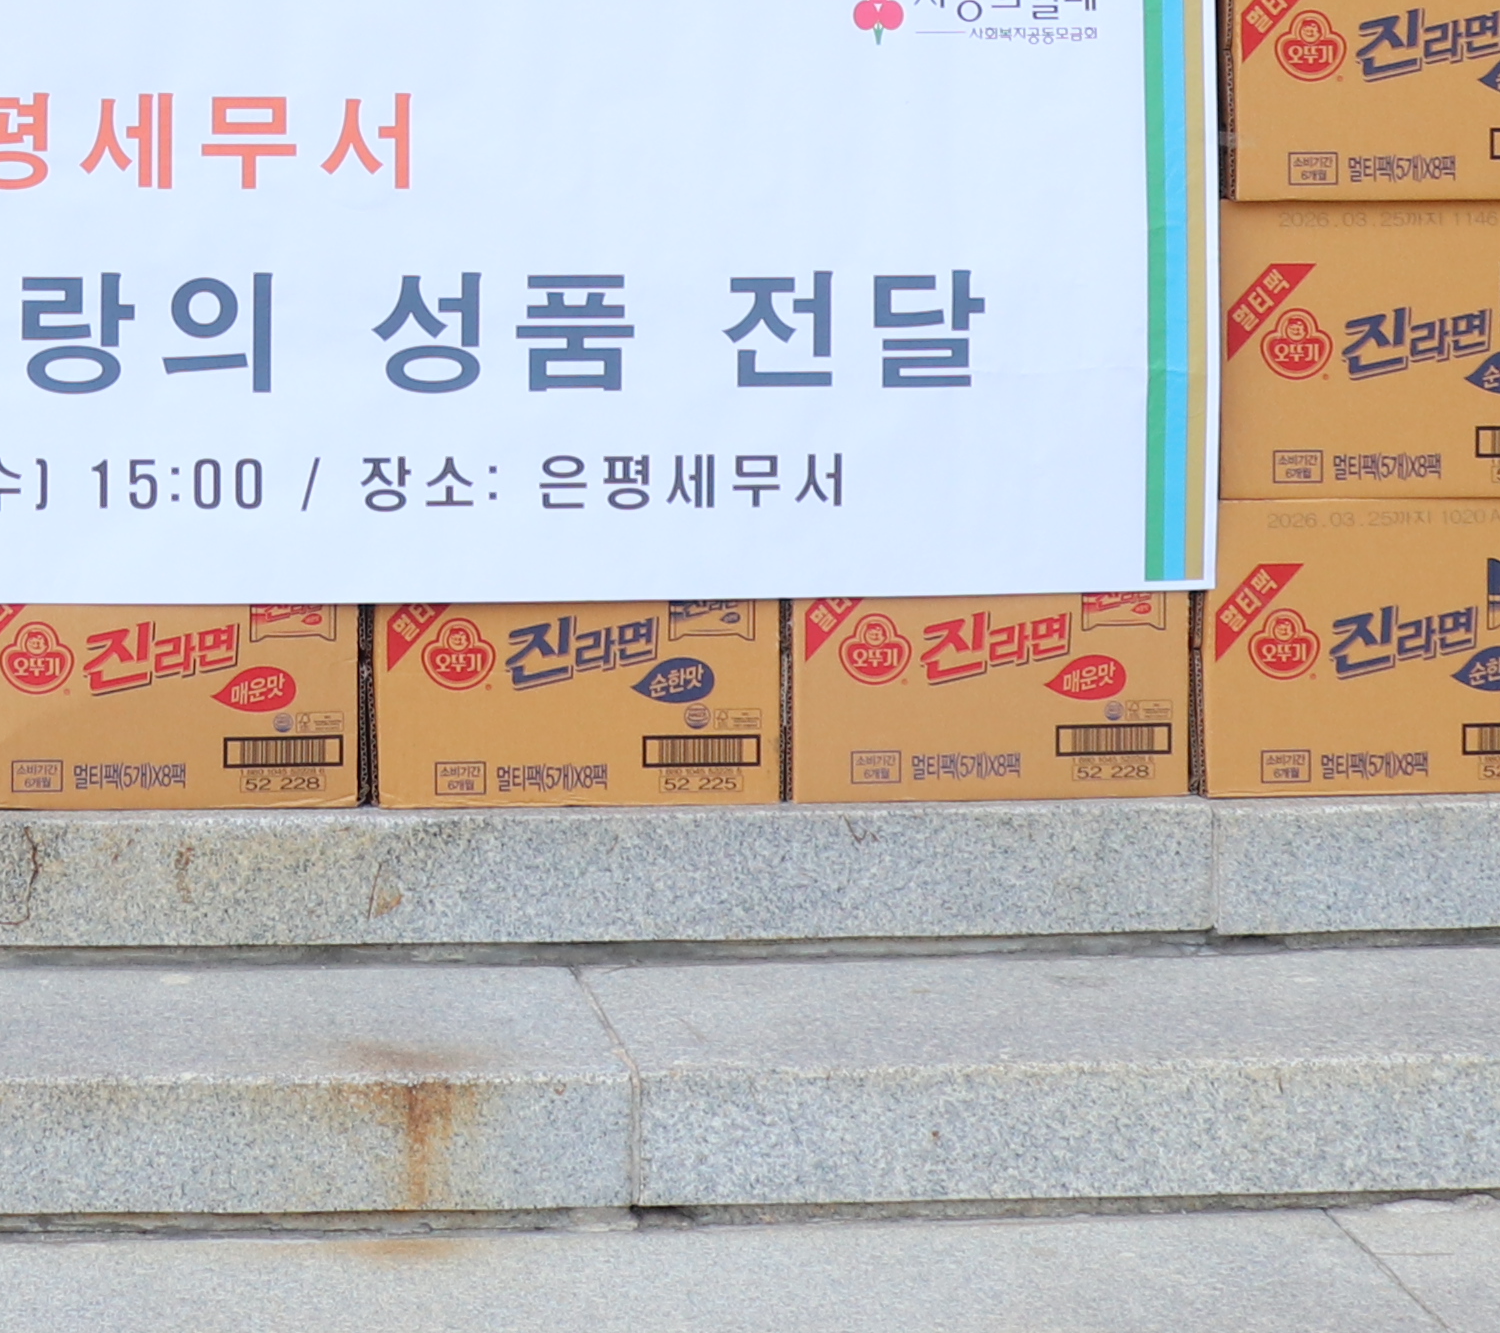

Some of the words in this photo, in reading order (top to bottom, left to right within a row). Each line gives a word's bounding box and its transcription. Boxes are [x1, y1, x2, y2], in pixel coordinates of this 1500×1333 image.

[968, 25, 1098, 44] 사회복지공동모금회
[371, 271, 636, 395] 성품
[722, 269, 987, 393] 전달
[1341, 306, 1492, 381] 진라면
[88, 457, 266, 511] 15:00
[359, 454, 500, 512] 장소:
[538, 452, 845, 510] 은평세무서
[82, 623, 241, 694] 진라면
[504, 613, 660, 691] 진라면
[919, 612, 1073, 684] 진라면
[1328, 602, 1479, 680] 진라면
